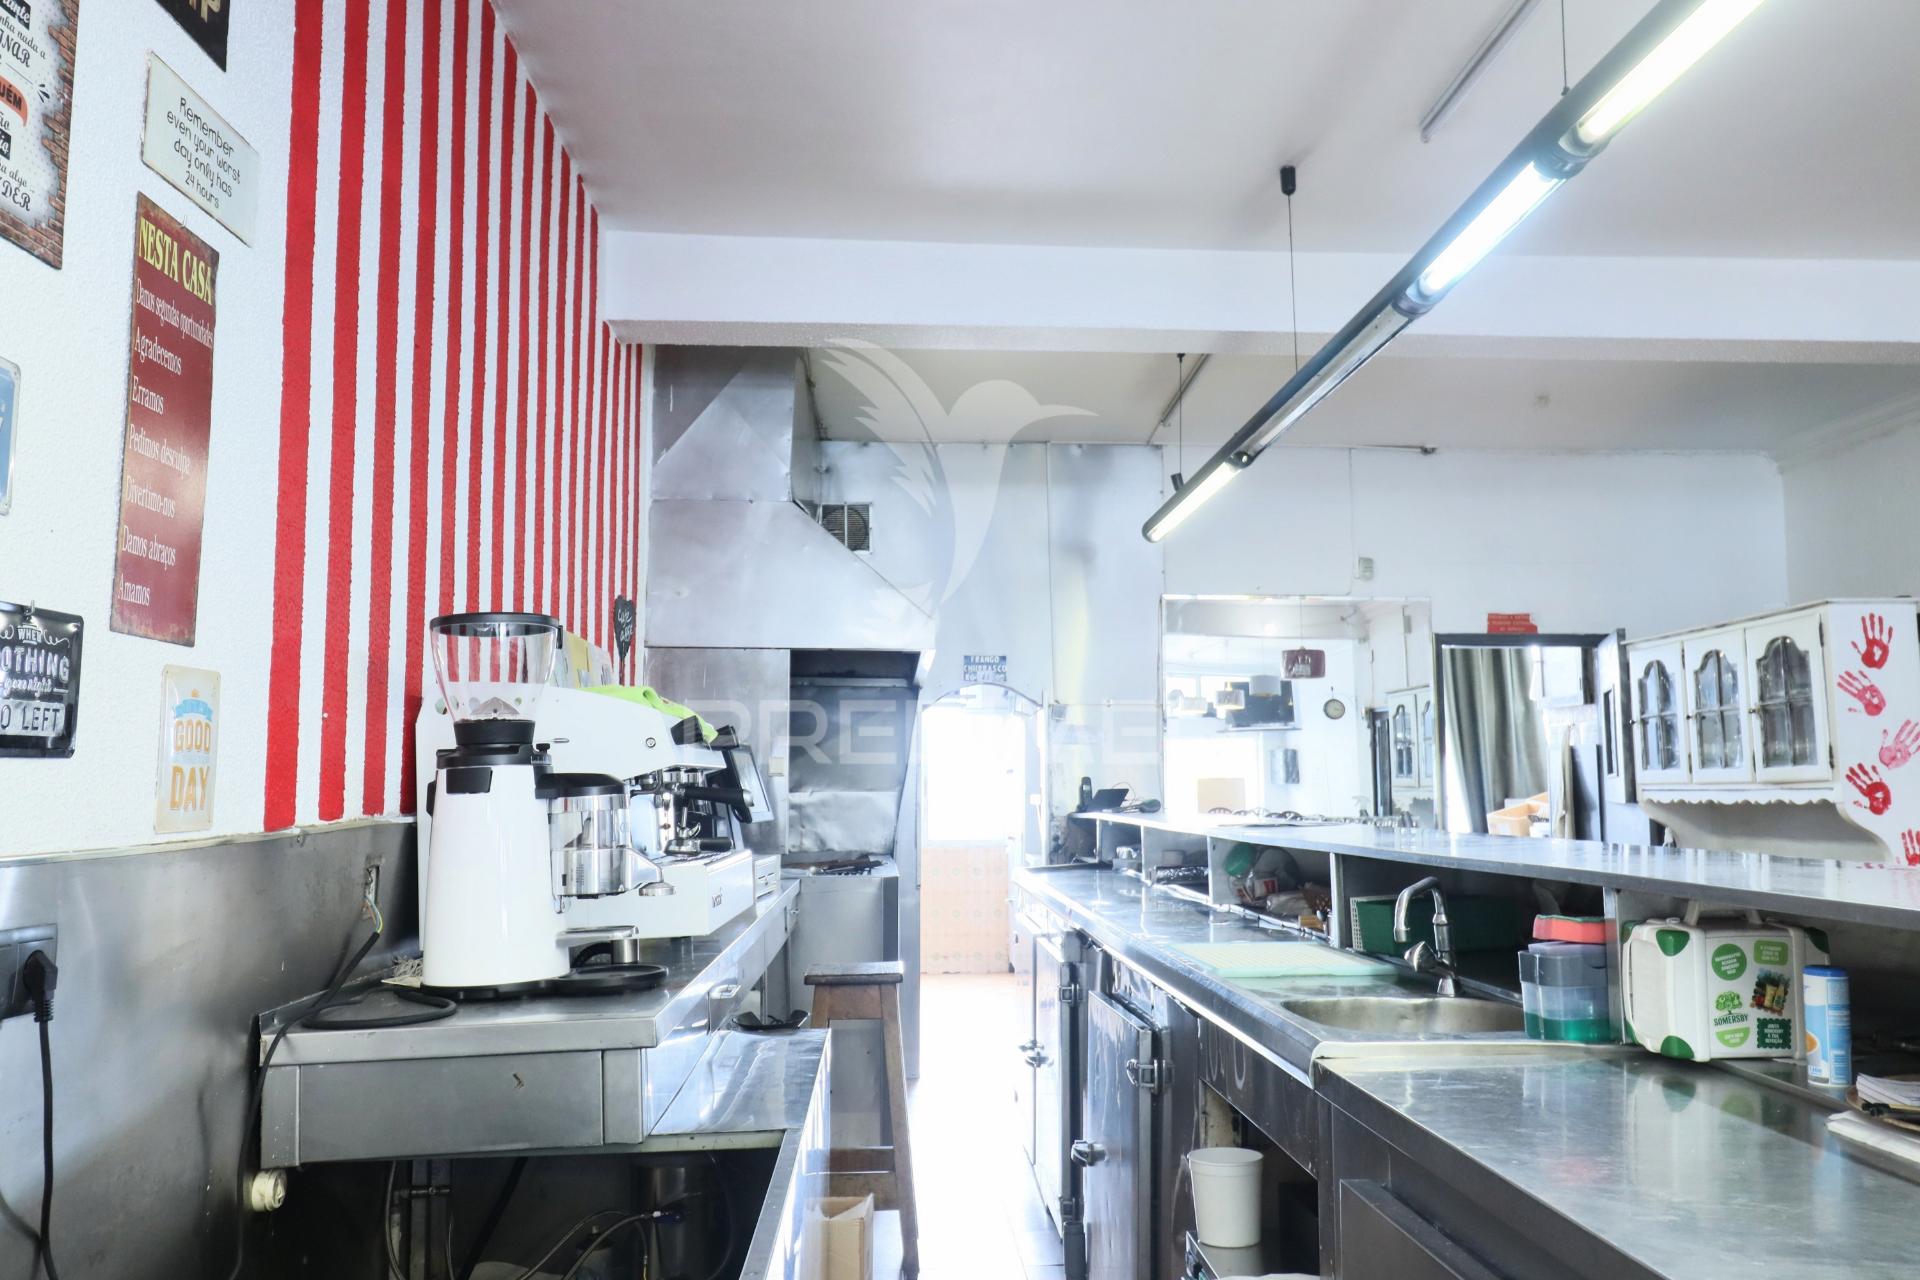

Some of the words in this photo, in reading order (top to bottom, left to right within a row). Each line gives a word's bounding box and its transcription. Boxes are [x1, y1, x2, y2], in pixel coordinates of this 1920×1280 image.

[0, 80, 22, 111] UÉM
[179, 97, 235, 158] Remember
[167, 111, 192, 140] even
[193, 134, 215, 158] your
[216, 154, 241, 185] worst
[174, 138, 192, 168] day
[194, 157, 215, 188] only
[216, 173, 232, 198] has
[185, 171, 195, 188] 24
[196, 179, 220, 209] hours
[138, 216, 179, 283] NESTA
[182, 249, 213, 305] CASA
[136, 278, 155, 313] Damos
[135, 327, 182, 376] Agradecemos
[132, 376, 164, 415] Erramos
[129, 424, 160, 461] Pedimos
[161, 439, 191, 480] desculpe
[122, 525, 148, 559] Damos
[149, 534, 176, 571] abraços
[118, 574, 150, 606] Amamos
[0, 646, 70, 684] OTHING
[21, 705, 60, 732] LEFT
[174, 719, 212, 753] GOOD
[170, 765, 210, 812] DAY
[1713, 1013, 1749, 1027] SOMERSBY
